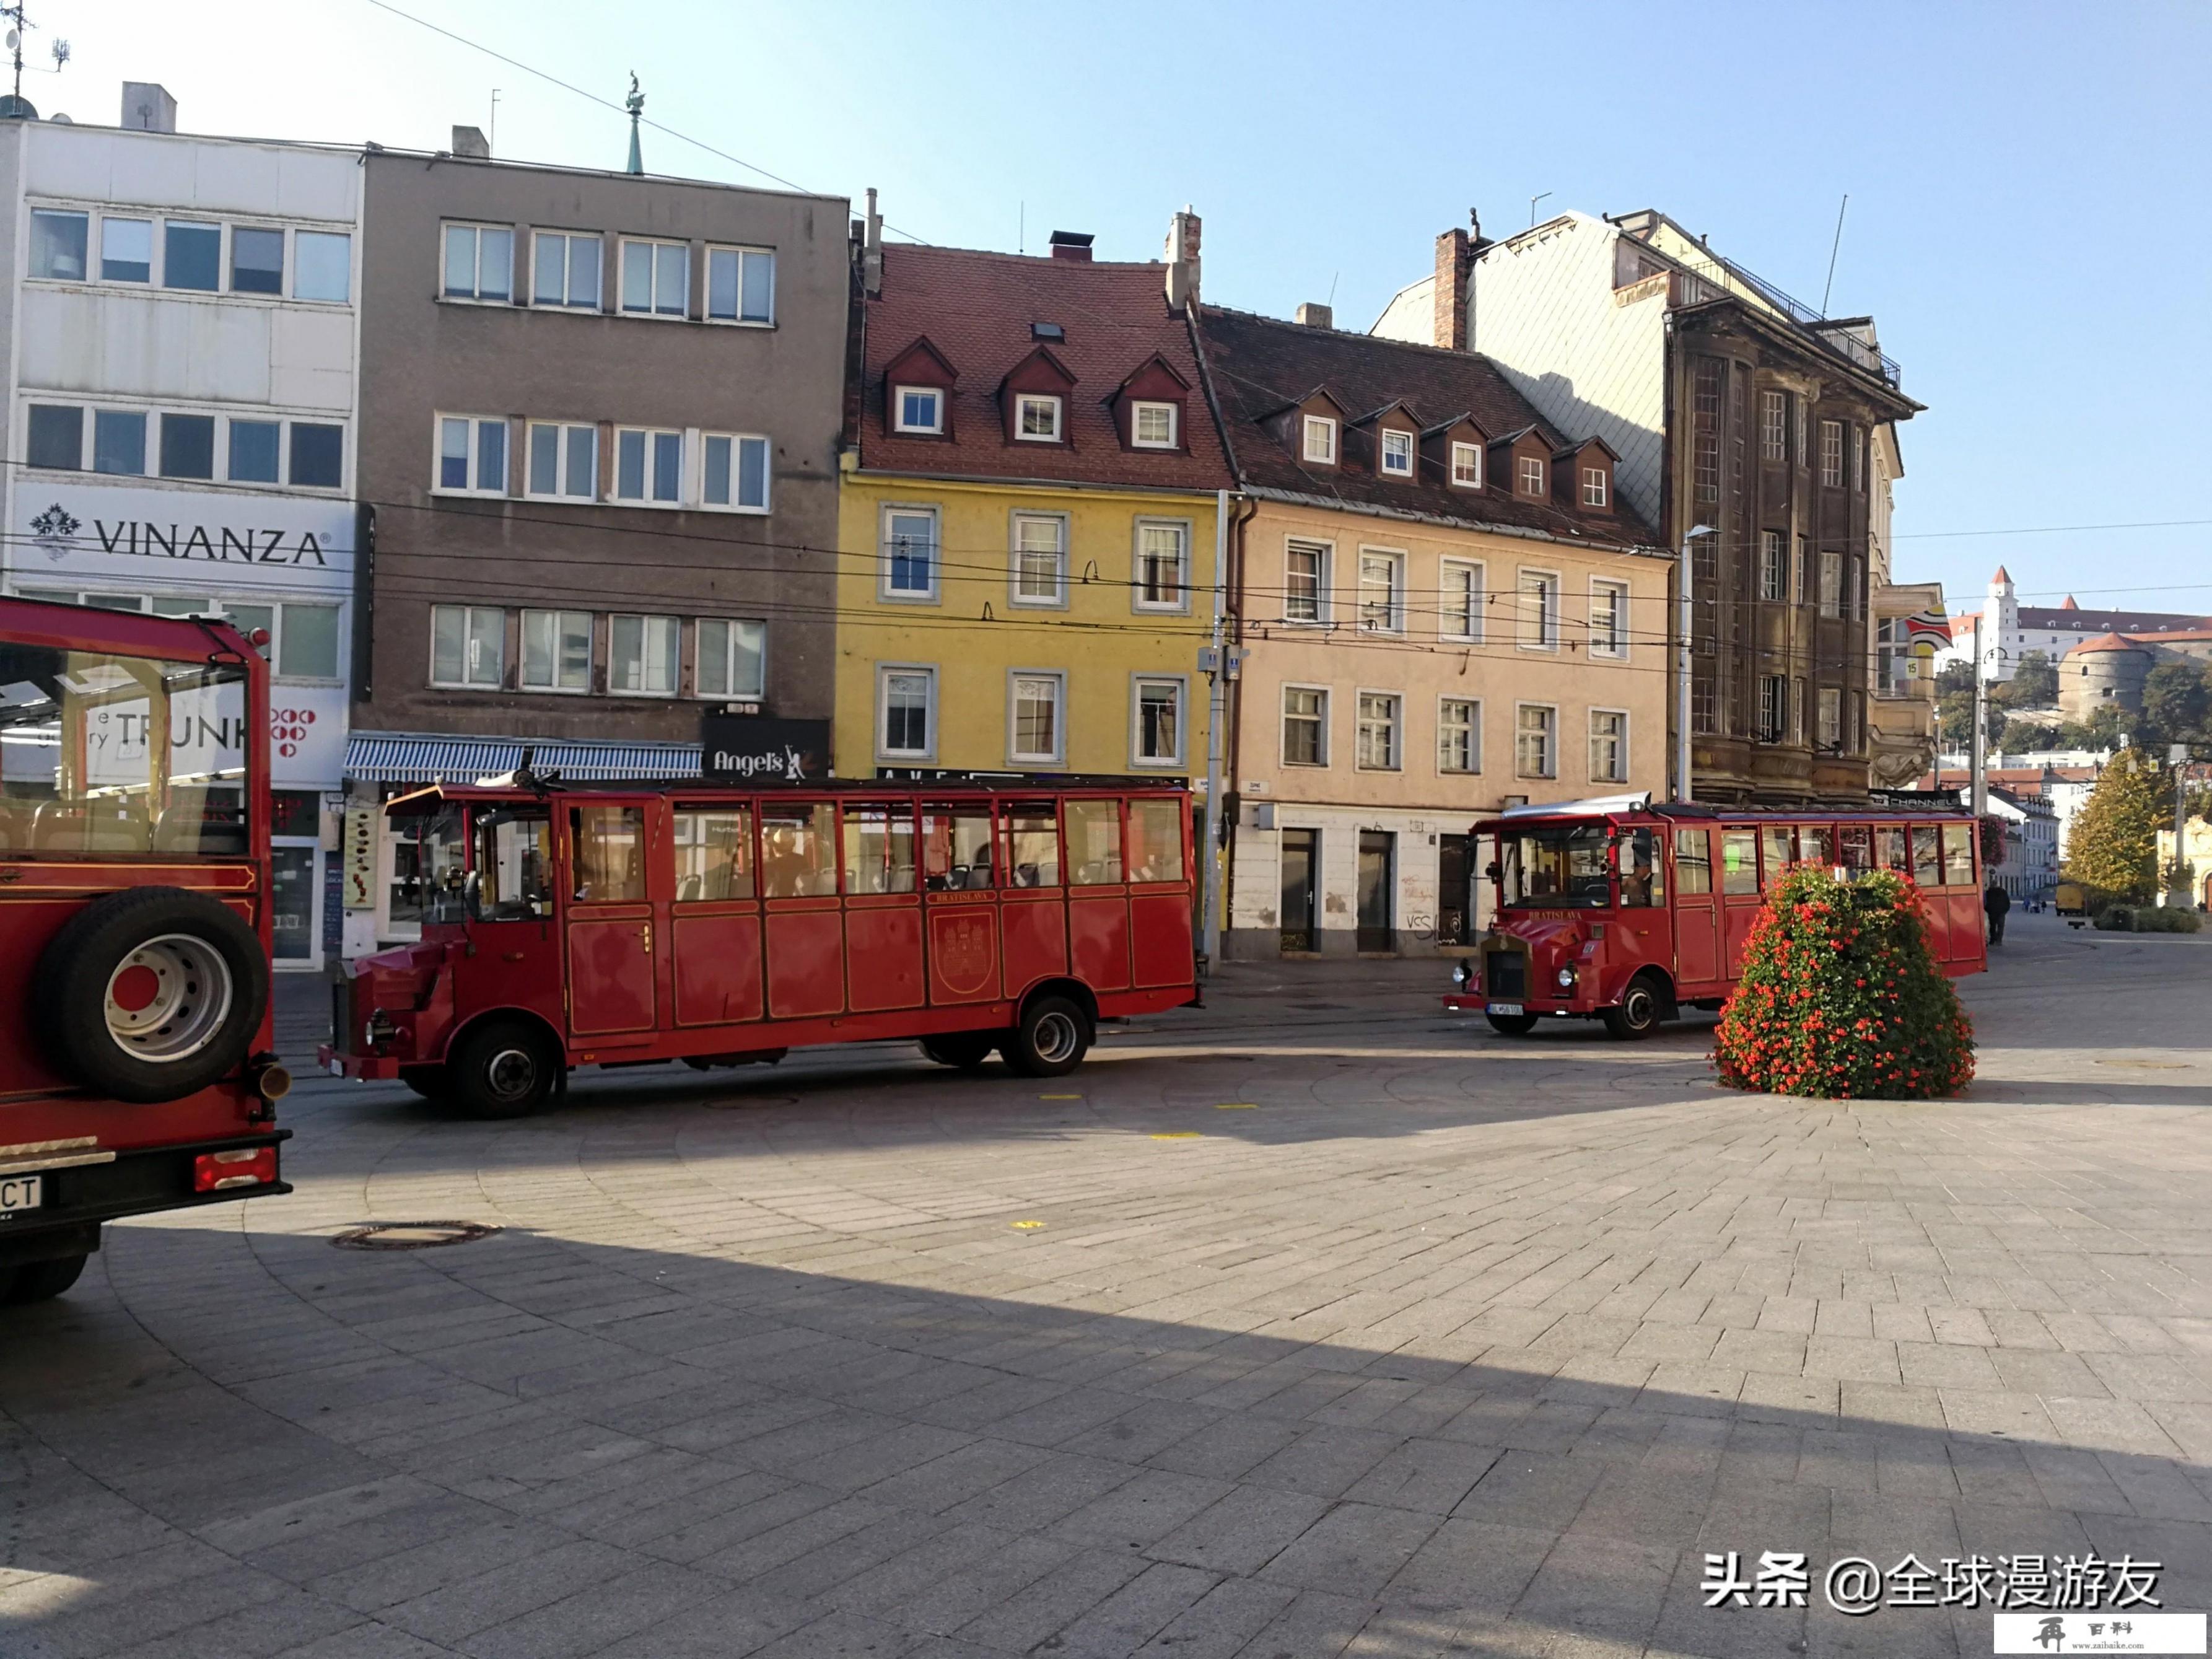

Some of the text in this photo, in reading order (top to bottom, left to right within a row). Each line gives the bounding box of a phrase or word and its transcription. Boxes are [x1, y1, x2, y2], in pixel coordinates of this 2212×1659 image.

[1908, 663, 1917, 673] 15
[714, 750, 784, 777] Angel's
[936, 893, 987, 903] BRATISLAVA
[1528, 911, 1582, 921] BRATISLAVA
